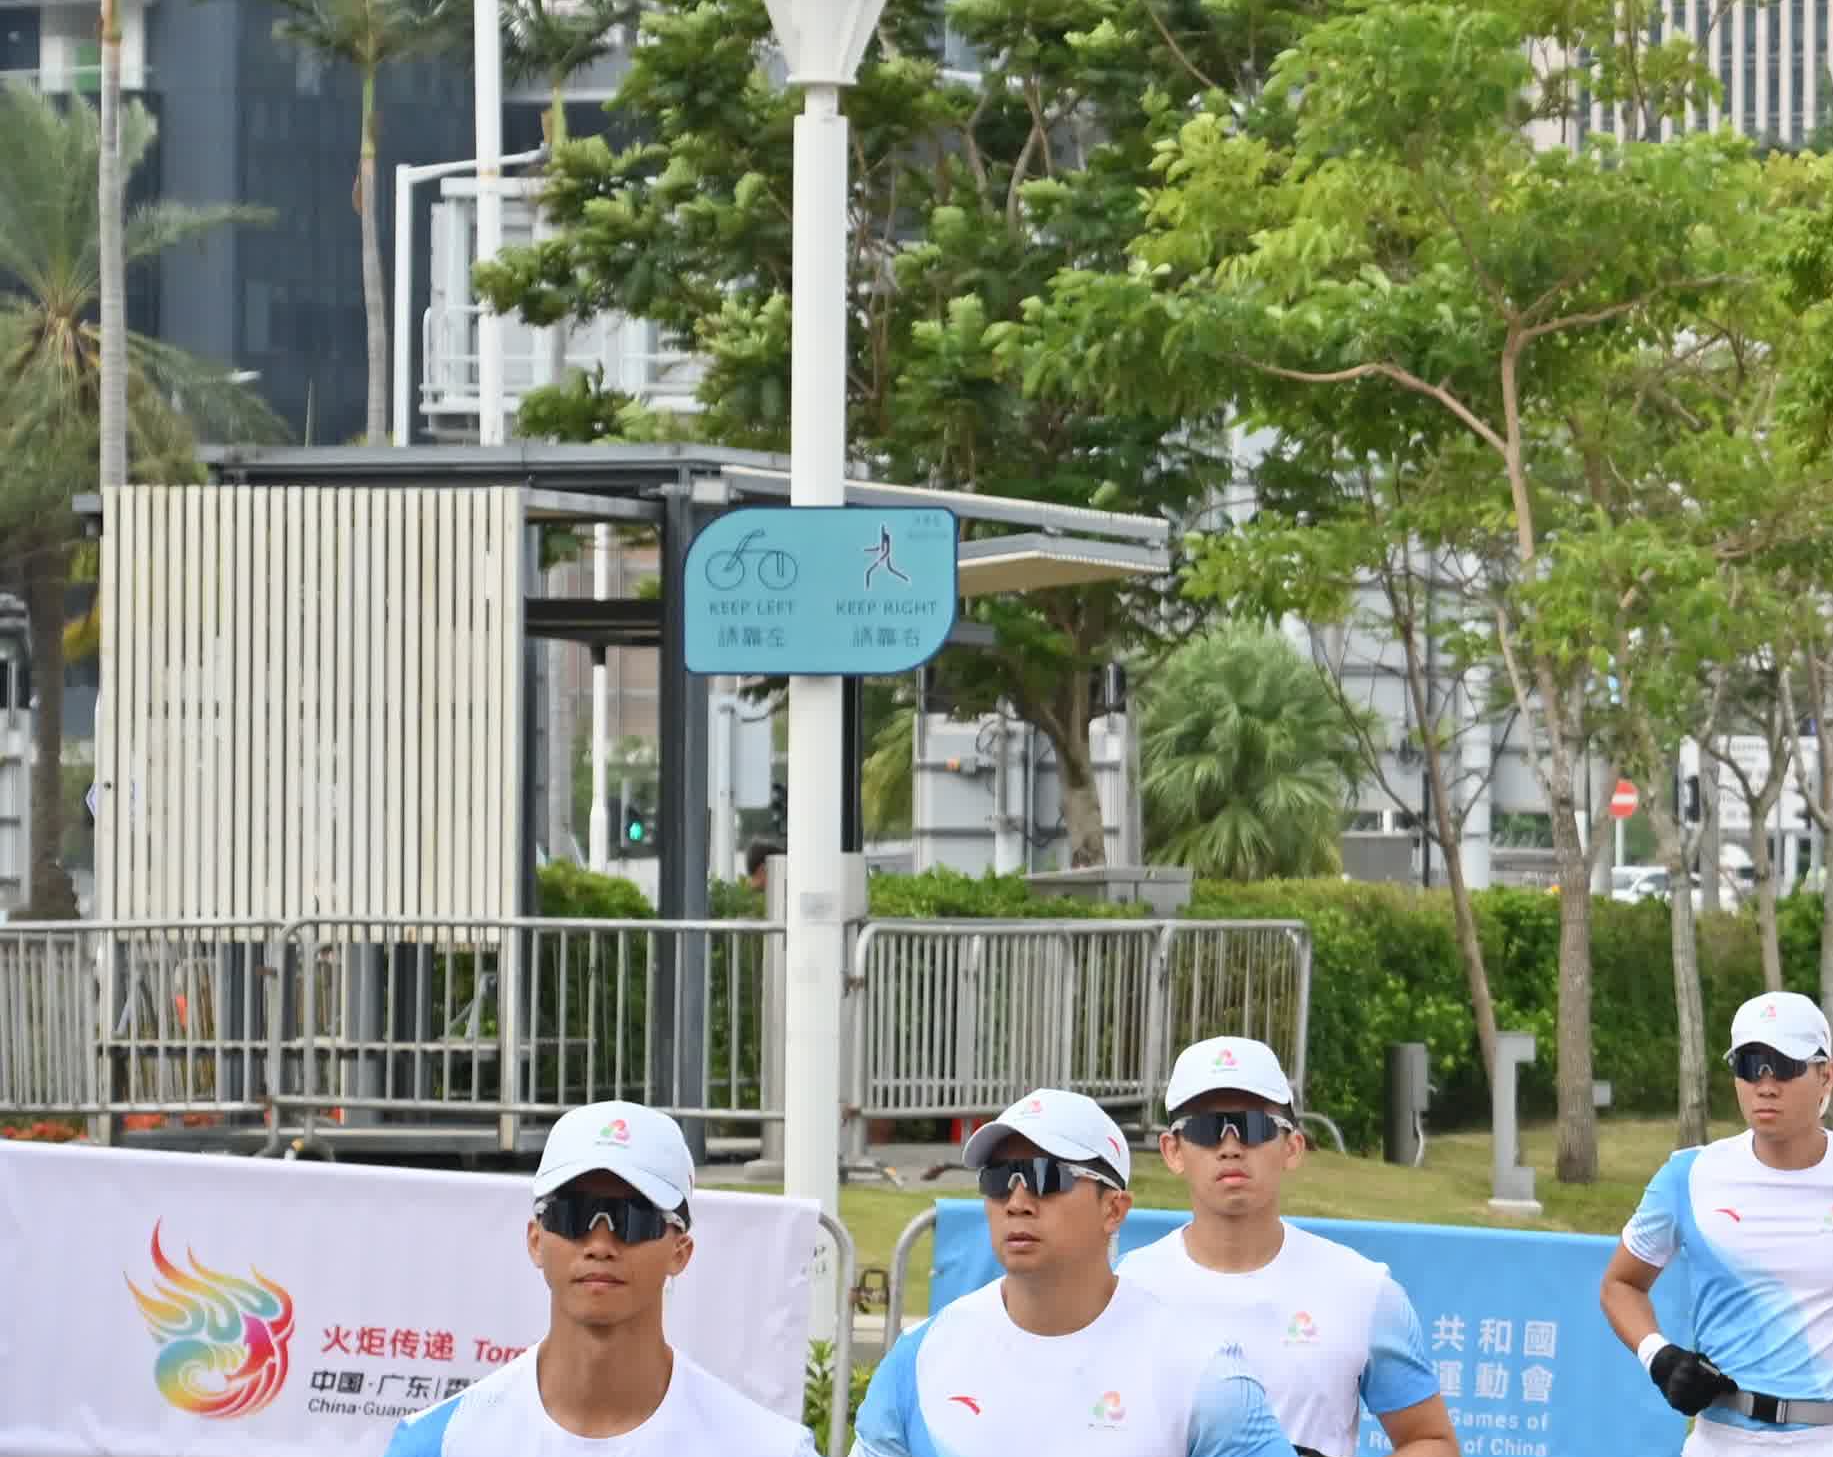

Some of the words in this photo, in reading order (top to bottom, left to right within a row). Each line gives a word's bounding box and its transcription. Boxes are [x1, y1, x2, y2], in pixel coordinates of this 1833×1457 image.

[707, 598, 751, 616] KEEP
[757, 598, 795, 616] LEFT
[836, 598, 878, 616] KEEP
[882, 598, 937, 616] RIGHT
[321, 1324, 455, 1361] 火炬传递
[1432, 1314, 1558, 1360] 共和國
[1432, 1360, 1553, 1402] 運動會
[1449, 1407, 1520, 1429] Games
[1527, 1410, 1550, 1431] of
[1463, 1436, 1486, 1455] of
[1490, 1437, 1549, 1457] China
